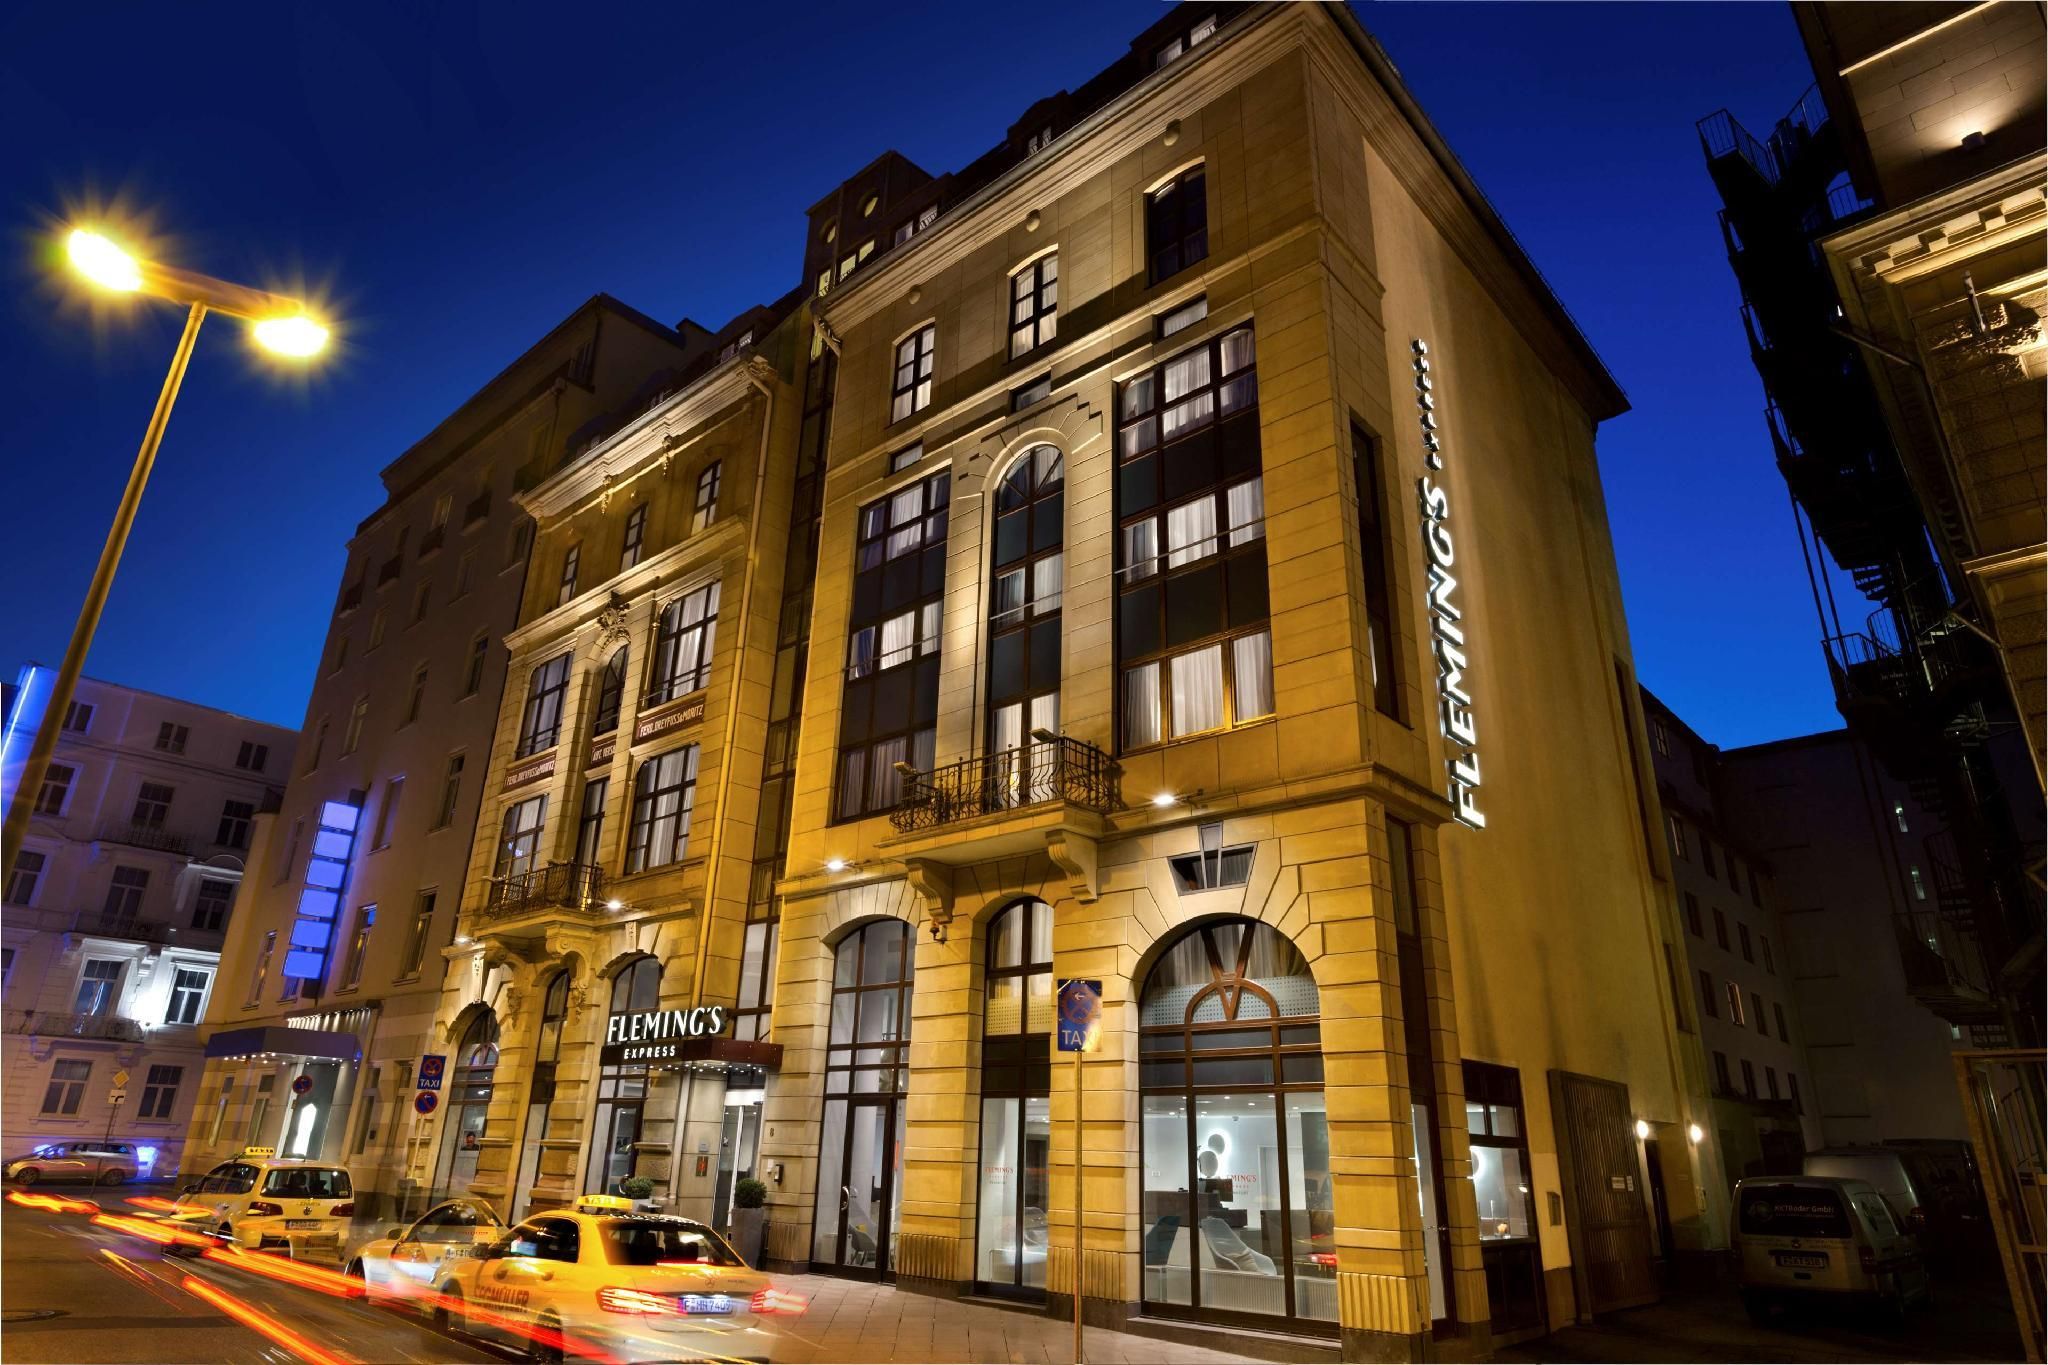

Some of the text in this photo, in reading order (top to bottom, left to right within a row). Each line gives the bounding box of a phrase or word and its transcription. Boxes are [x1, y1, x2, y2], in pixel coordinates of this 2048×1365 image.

[1416, 338, 1442, 471] EXPRESS
[607, 1005, 722, 1043] FLEMING'S
[624, 1045, 676, 1060] EXPRESS
[419, 1078, 440, 1088] TAXI
